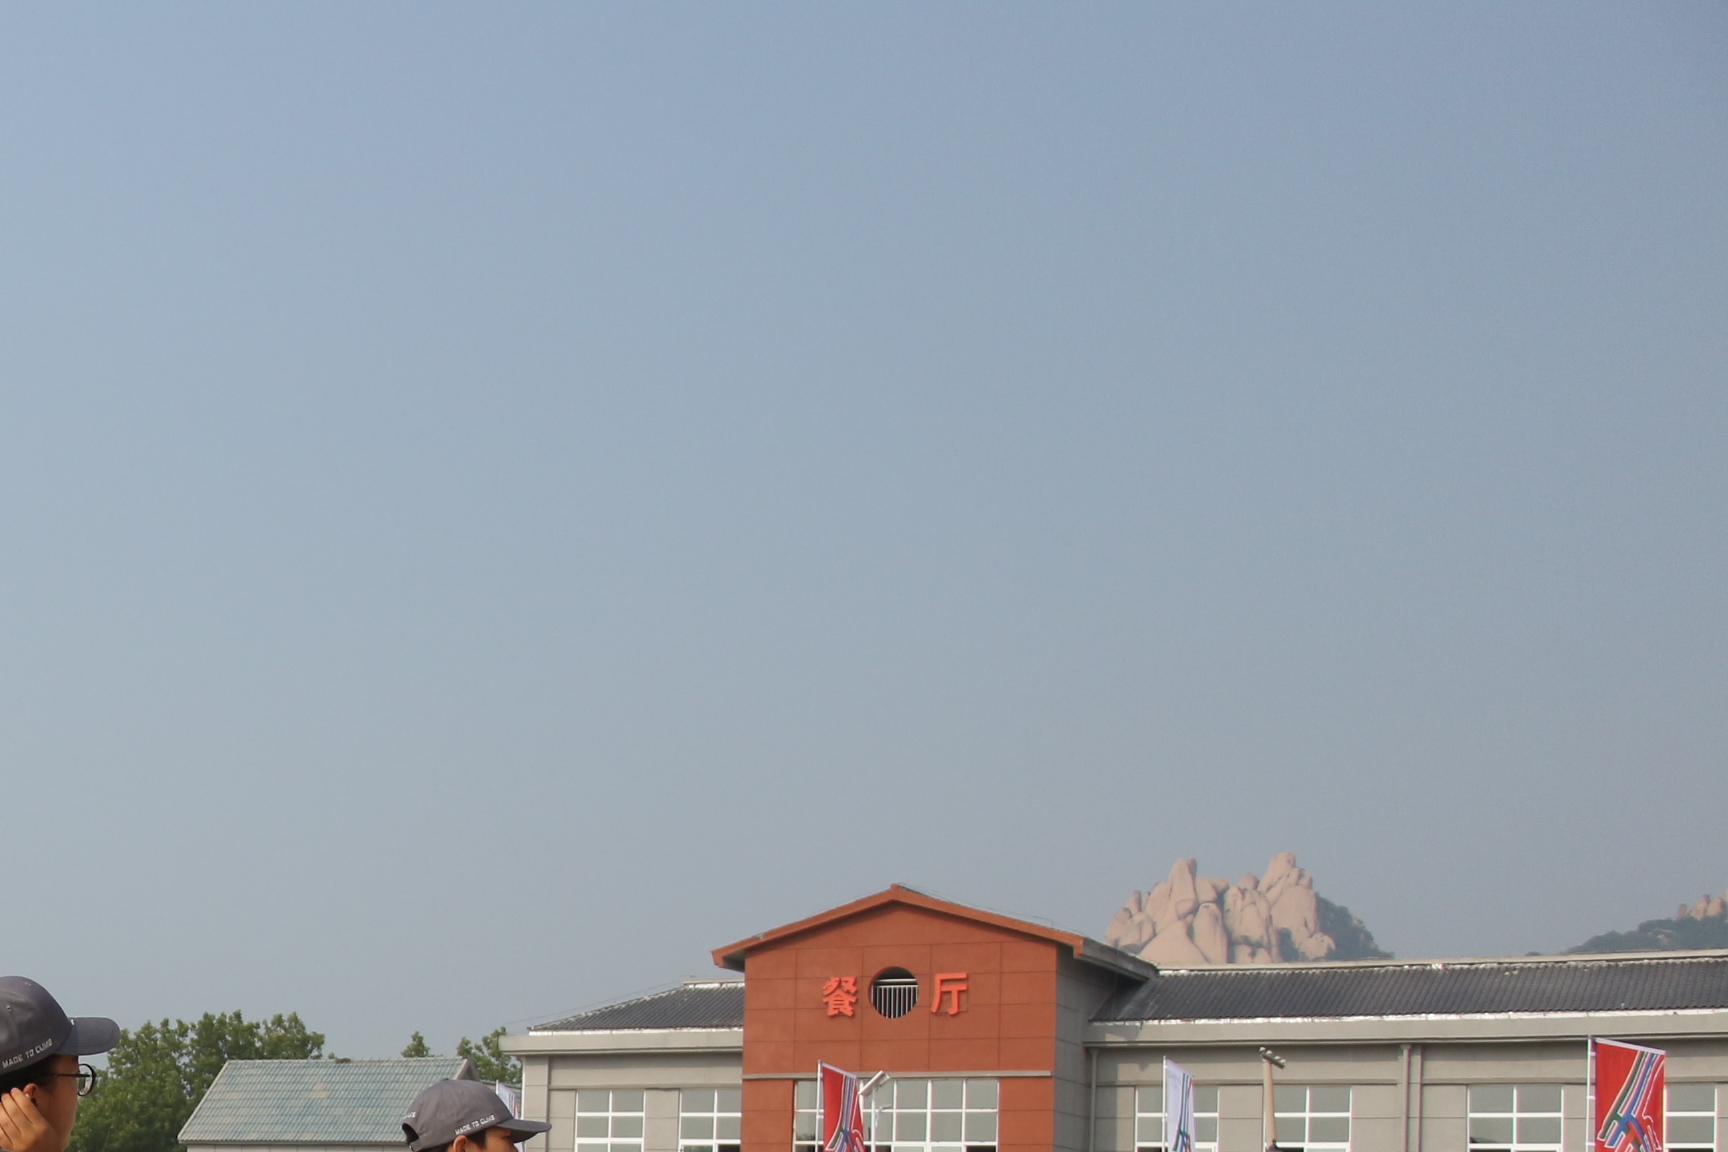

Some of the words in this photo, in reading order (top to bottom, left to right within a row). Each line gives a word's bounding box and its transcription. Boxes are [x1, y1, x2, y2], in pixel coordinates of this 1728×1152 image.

[822, 972, 969, 1017] 餐厅
[2, 1056, 24, 1069] MADE
[25, 1049, 35, 1059] TO
[35, 1038, 53, 1053] CLIMB
[454, 1124, 471, 1135] MADE
[472, 1120, 480, 1128] TO
